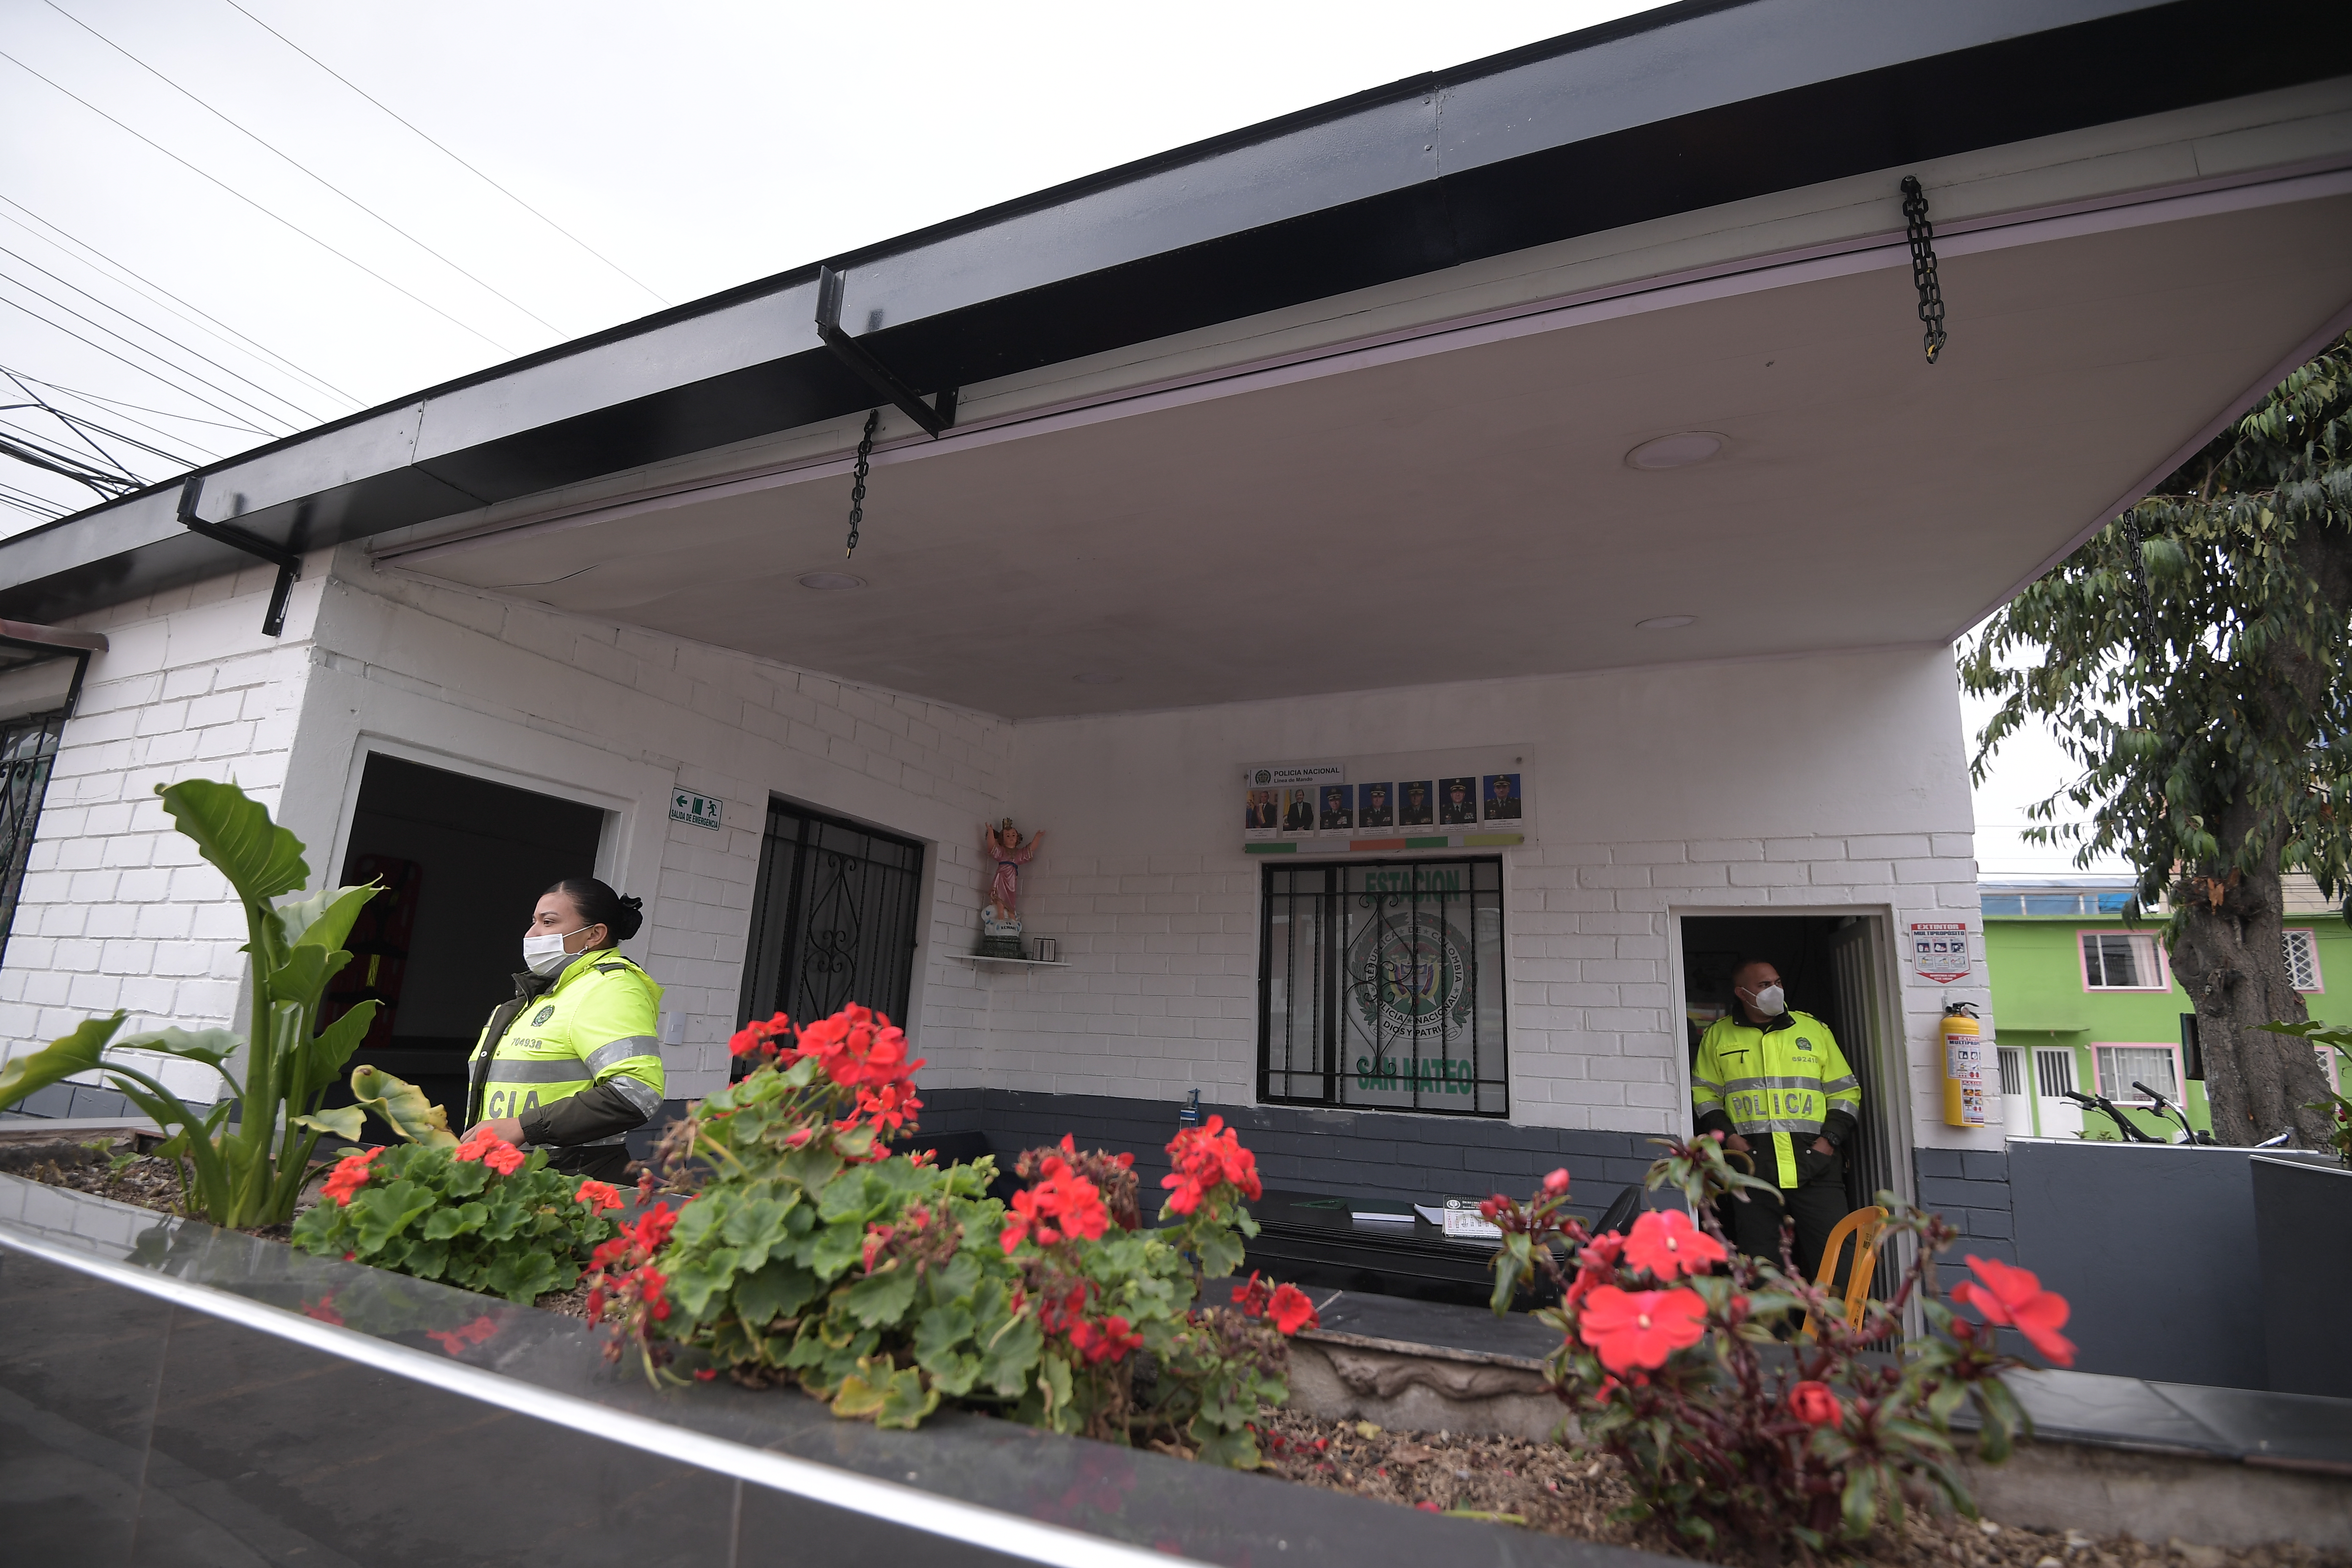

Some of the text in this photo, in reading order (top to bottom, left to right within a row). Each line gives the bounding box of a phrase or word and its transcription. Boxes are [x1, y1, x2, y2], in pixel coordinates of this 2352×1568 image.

[671, 809, 718, 829] SALIDA DE EMERGENCIA
[1365, 870, 1459, 904] ESTACION
[1432, 932, 1462, 983] COLOMBIA
[1416, 994, 1458, 1024] NACIONAL
[1383, 1021, 1405, 1035] DIOS
[511, 1037, 542, 1050] 704938
[1358, 1055, 1473, 1094] SAN MATEO
